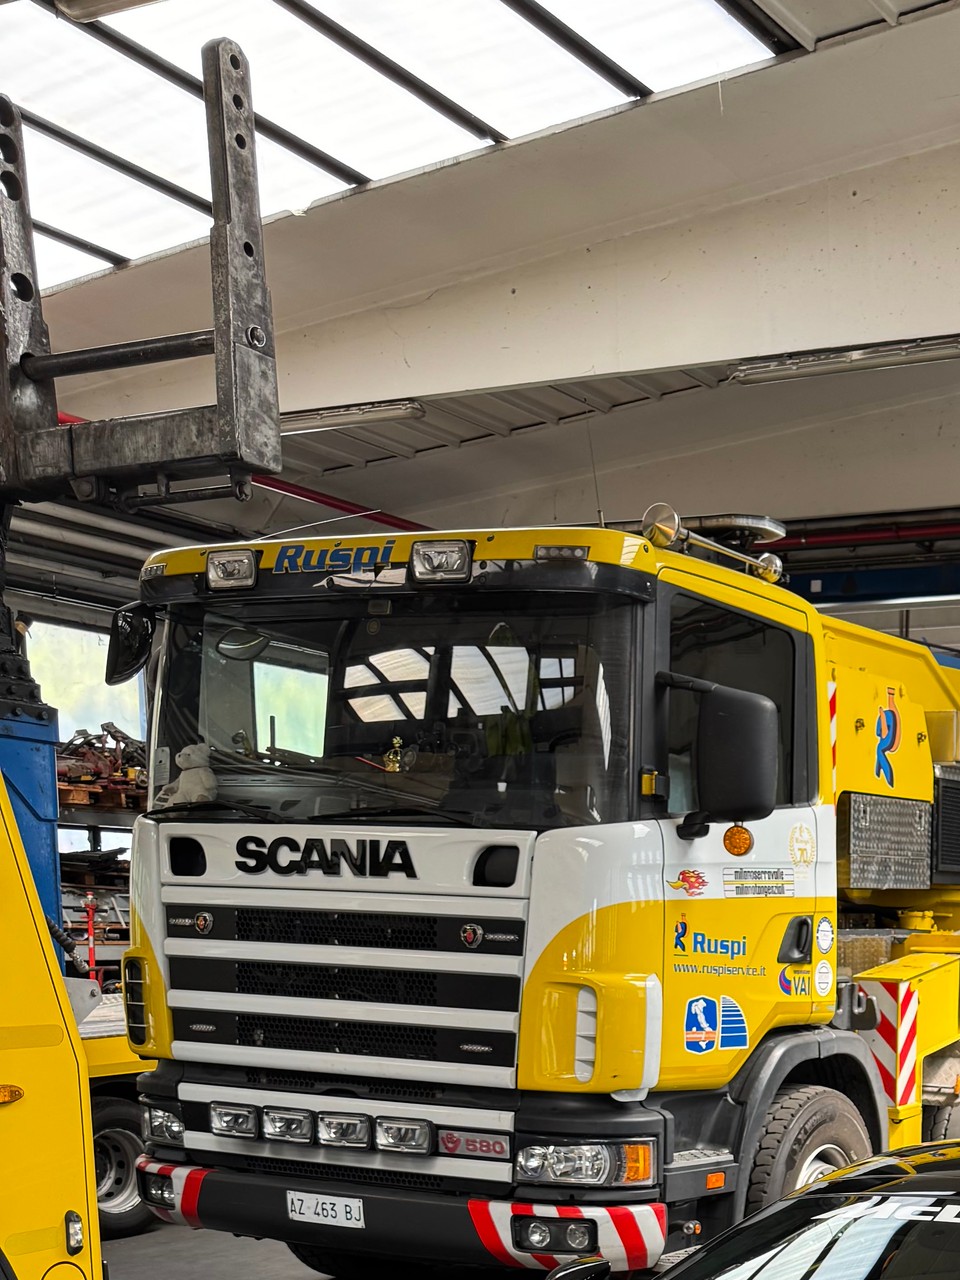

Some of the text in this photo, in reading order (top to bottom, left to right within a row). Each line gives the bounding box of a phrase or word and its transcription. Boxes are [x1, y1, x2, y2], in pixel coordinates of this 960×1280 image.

[272, 539, 396, 576] Ruspi
[235, 836, 418, 879] SCANIA
[693, 932, 747, 960] Ruspi
[673, 963, 767, 977] www.ruspiservice.it
[464, 1138, 506, 1156] 580
[290, 1198, 362, 1222] AZ 463 BJ
